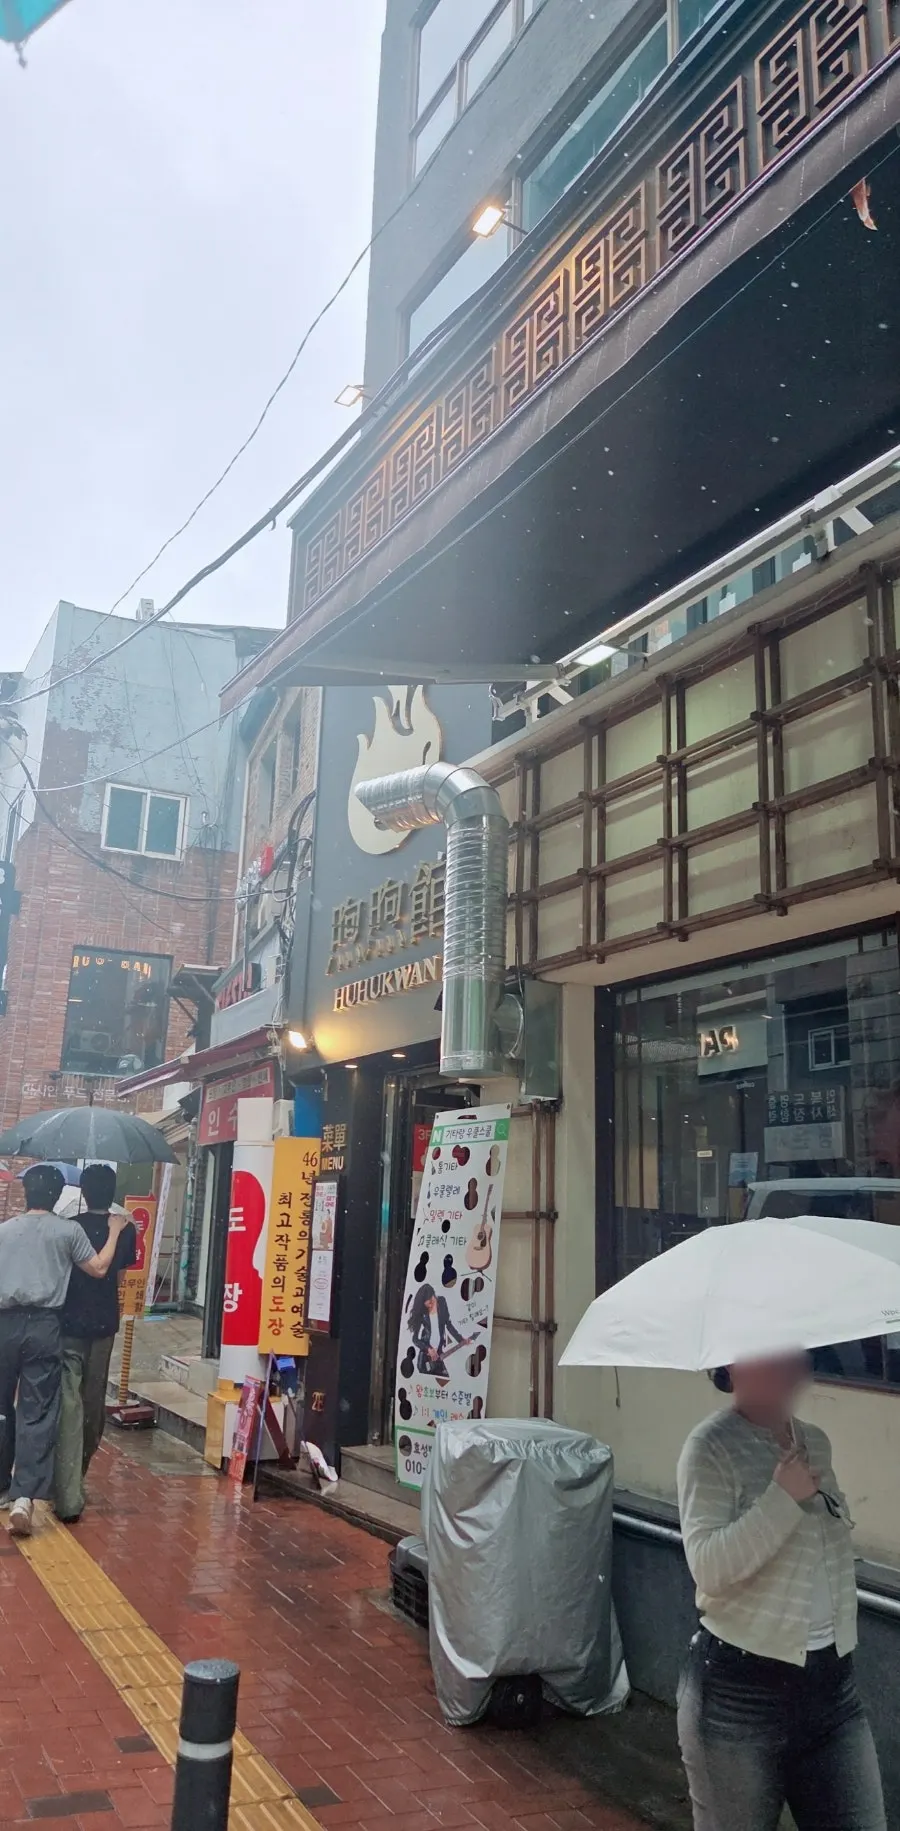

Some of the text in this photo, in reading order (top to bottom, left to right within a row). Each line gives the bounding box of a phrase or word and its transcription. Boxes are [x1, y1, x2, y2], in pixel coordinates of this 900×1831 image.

[332, 955, 440, 1012] HUHUKWAN
[63, 1086, 88, 1099] 푸드
[321, 1124, 347, 1152] 菜單
[445, 1124, 492, 1140] 기타랑 우쿨스쿨
[321, 1156, 344, 1170] MENU
[438, 1160, 458, 1175] 통기타
[433, 1184, 460, 1199] 우쿨렐레
[448, 1210, 463, 1220] 기타
[425, 1234, 468, 1248] 클래식 기타
[267, 1296, 286, 1337] 도장
[415, 1384, 472, 1406] 왕초보부터 수준별
[433, 1409, 448, 1423] 개인
